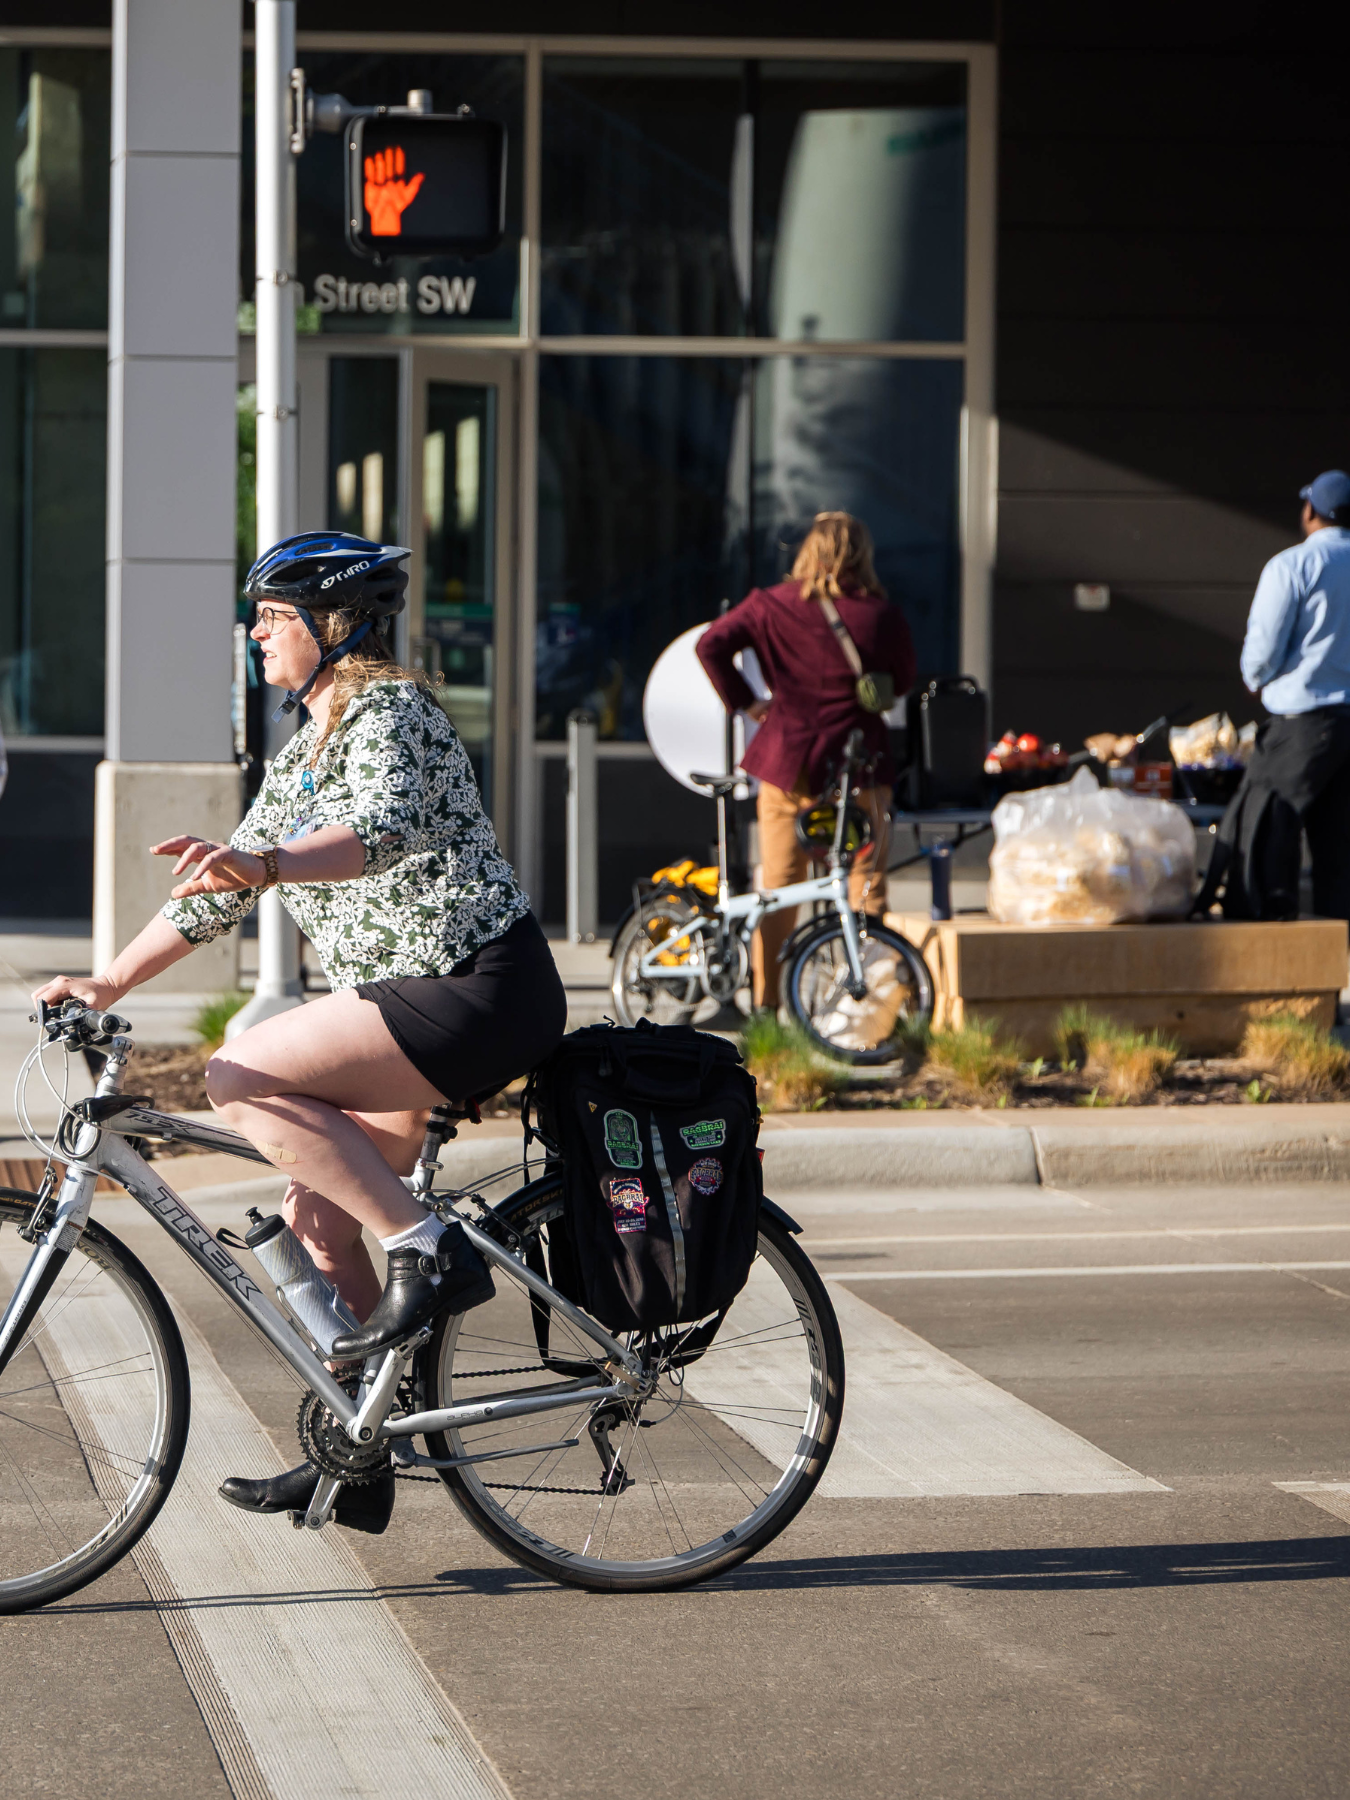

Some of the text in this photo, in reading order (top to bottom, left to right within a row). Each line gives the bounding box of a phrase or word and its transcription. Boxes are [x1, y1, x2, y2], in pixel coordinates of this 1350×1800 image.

[314, 274, 410, 313] Street
[417, 275, 476, 314] SW
[682, 1121, 723, 1136] RAGBRAI
[153, 1186, 263, 1300] TREK
